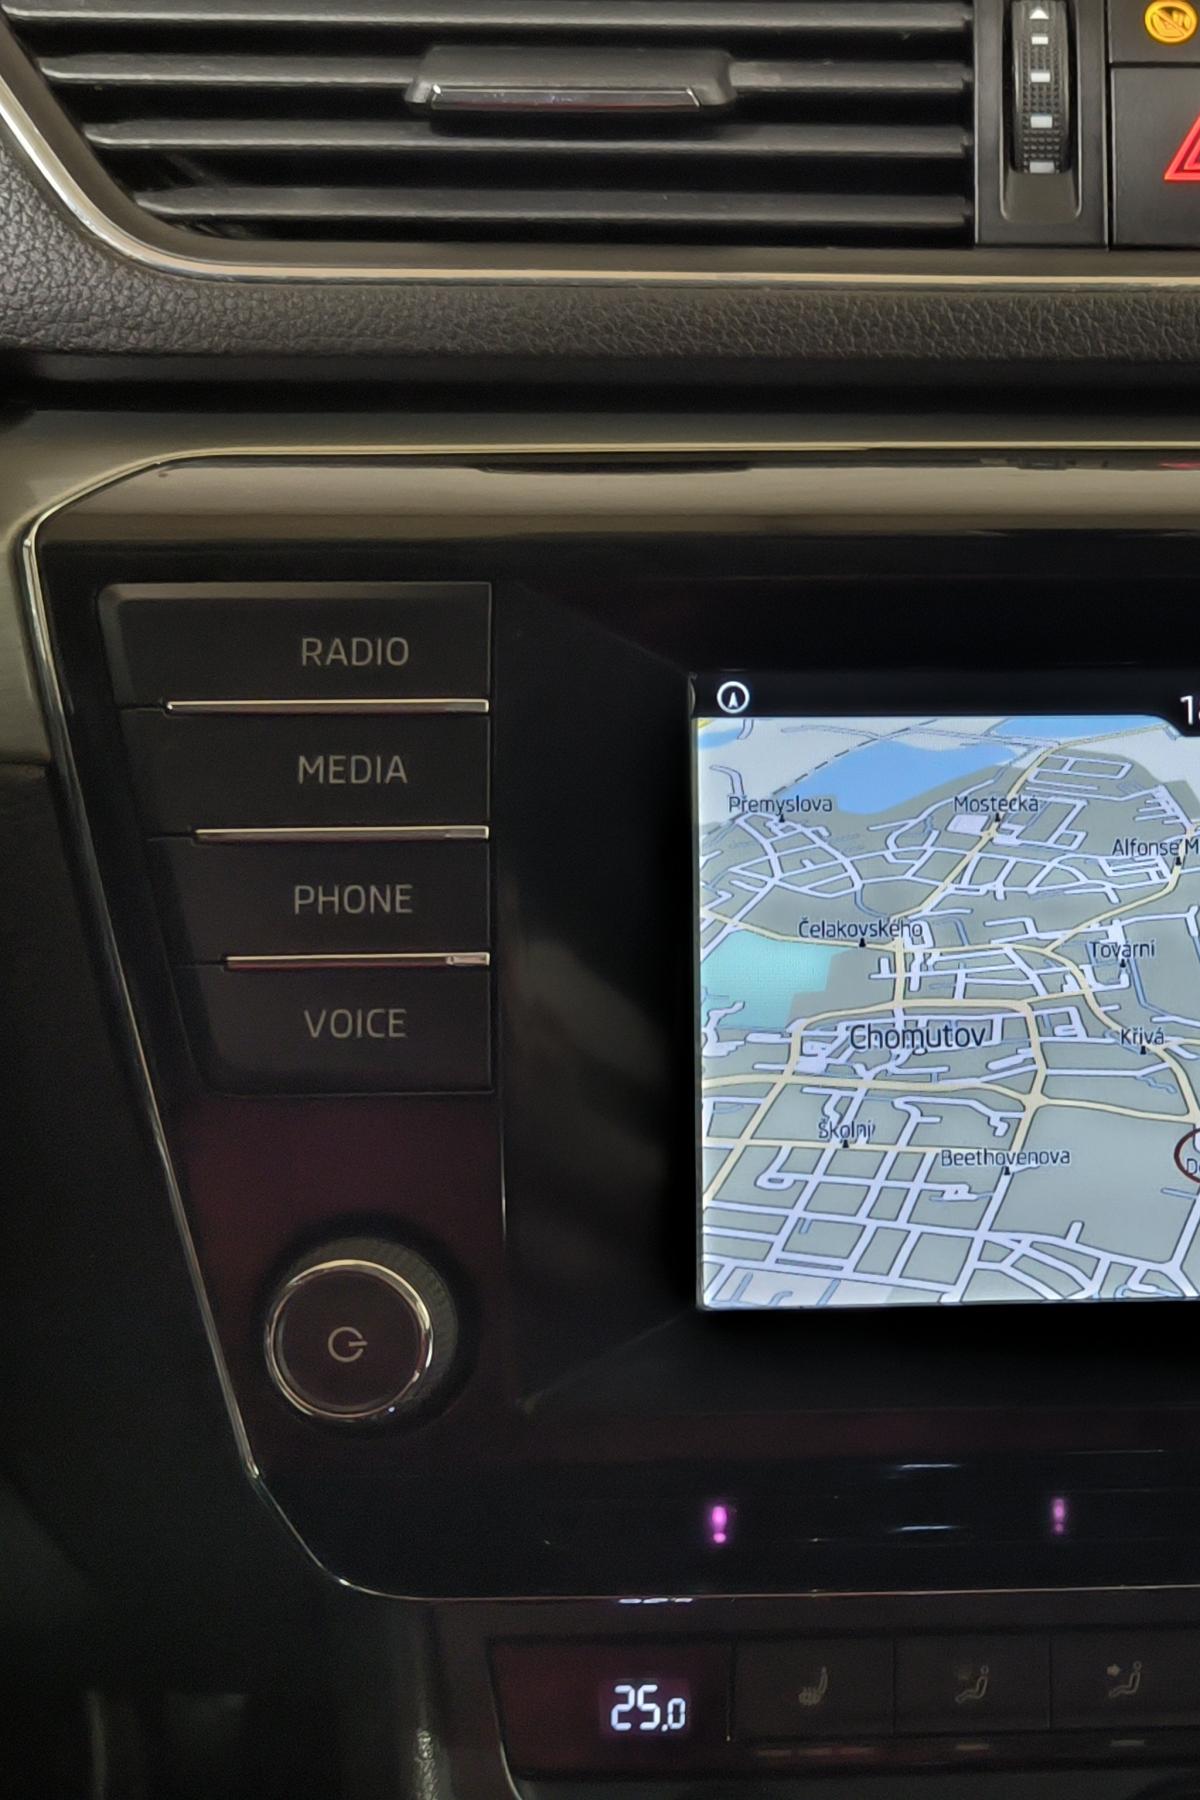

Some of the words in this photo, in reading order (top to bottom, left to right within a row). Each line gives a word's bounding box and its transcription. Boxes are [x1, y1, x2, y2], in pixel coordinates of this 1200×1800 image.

[301, 637, 411, 667] RADIO
[297, 755, 409, 785] MEDIA
[728, 796, 833, 820] Přemyslova
[954, 795, 1040, 813] Mostecká
[1113, 839, 1180, 857] Alfonse
[294, 883, 414, 914] PHONE
[799, 917, 923, 940] Čelakovského
[303, 1008, 408, 1039] VOICE
[850, 1022, 987, 1052] Chomutov
[1121, 1027, 1166, 1047] Křivá
[940, 1149, 1071, 1168] Beethovenova
[610, 1684, 687, 1732] 25.0
